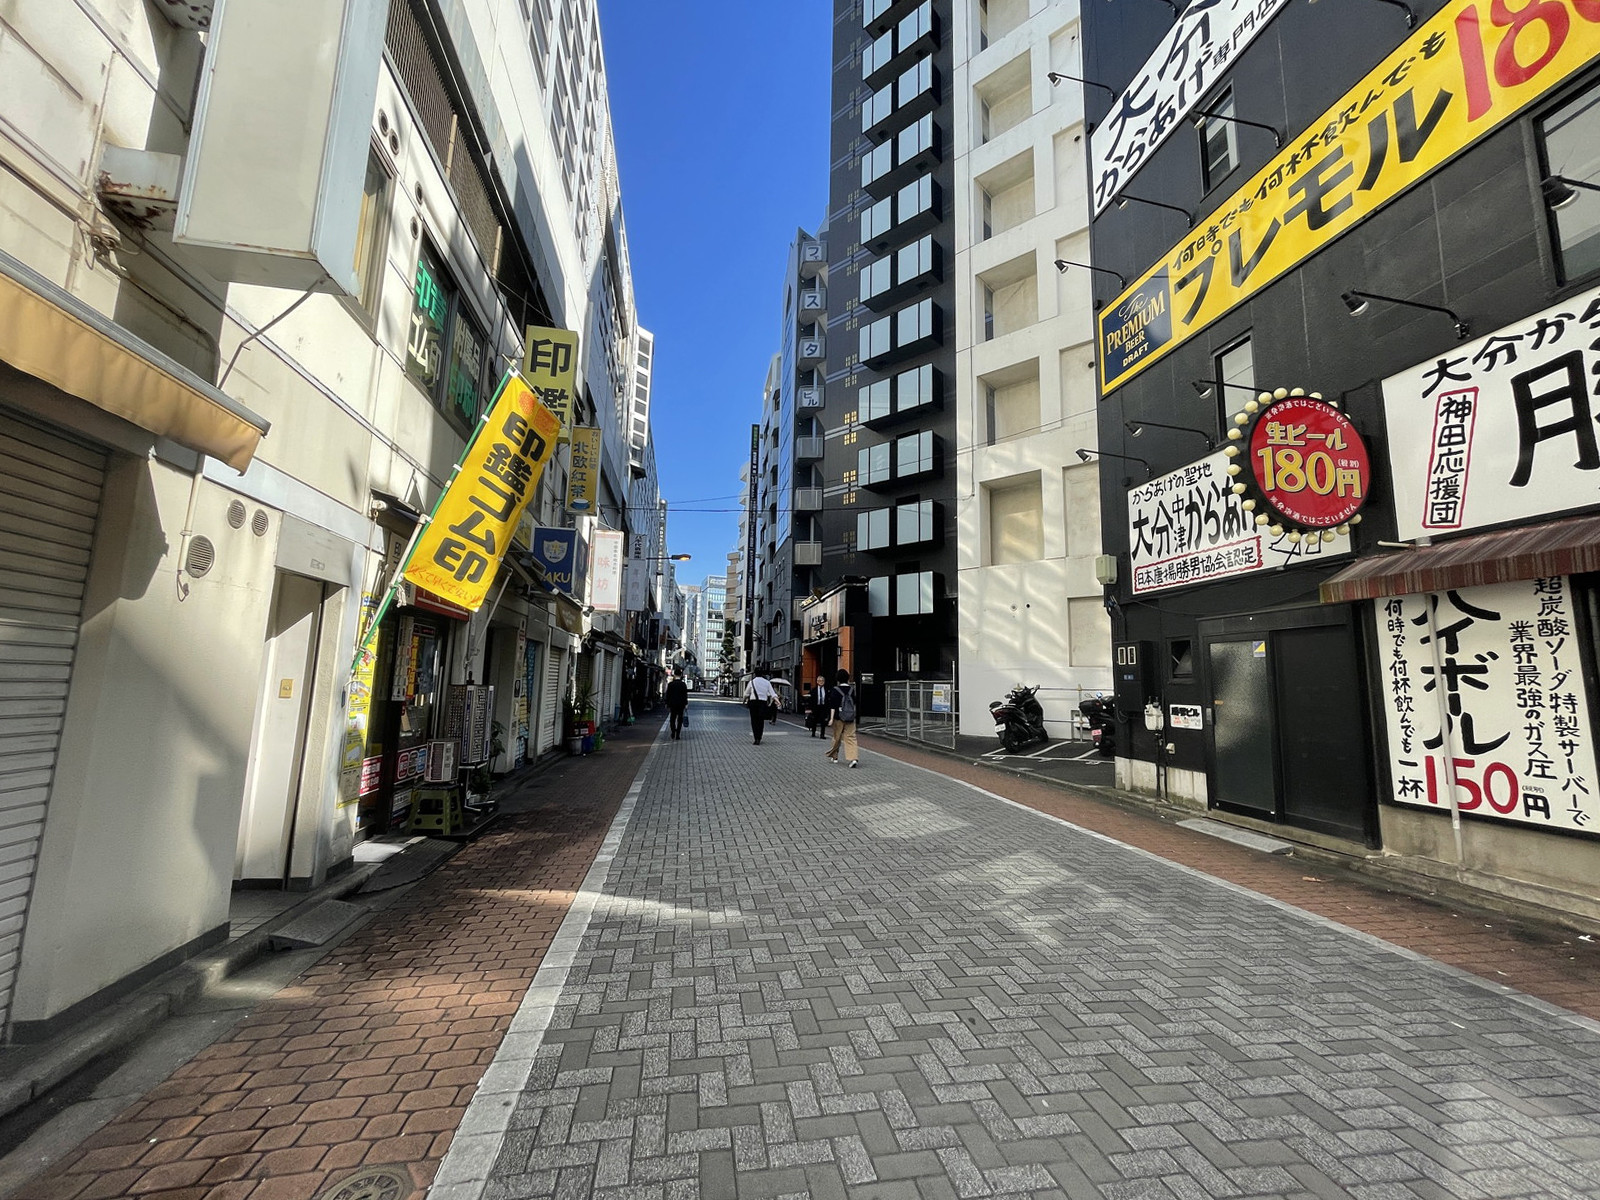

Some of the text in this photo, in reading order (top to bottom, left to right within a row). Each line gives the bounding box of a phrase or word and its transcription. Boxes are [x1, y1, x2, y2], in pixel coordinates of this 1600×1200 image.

[1105, 0, 1238, 161] 大分
[1174, 0, 1600, 326] プレモル 18
[1106, 290, 1166, 355] PREMIUM
[1119, 293, 1148, 321] The
[1123, 342, 1149, 367] DRAFT
[1125, 331, 1145, 353] BEER
[1265, 421, 1348, 451] 生ビール
[1429, 395, 1472, 524] 神田応援団
[433, 411, 546, 584] 印鑑ゴム印
[571, 441, 588, 498] 北欧紅茶
[1132, 462, 1213, 505] からあげの聖地
[1137, 546, 1257, 586] 日本唐揚勝男協会認定
[1411, 590, 1511, 755] ハイボール
[1508, 620, 1558, 780] 業界最強のガス圧
[1534, 576, 1591, 827] 超炭酸ソーダ特製サーバーで
